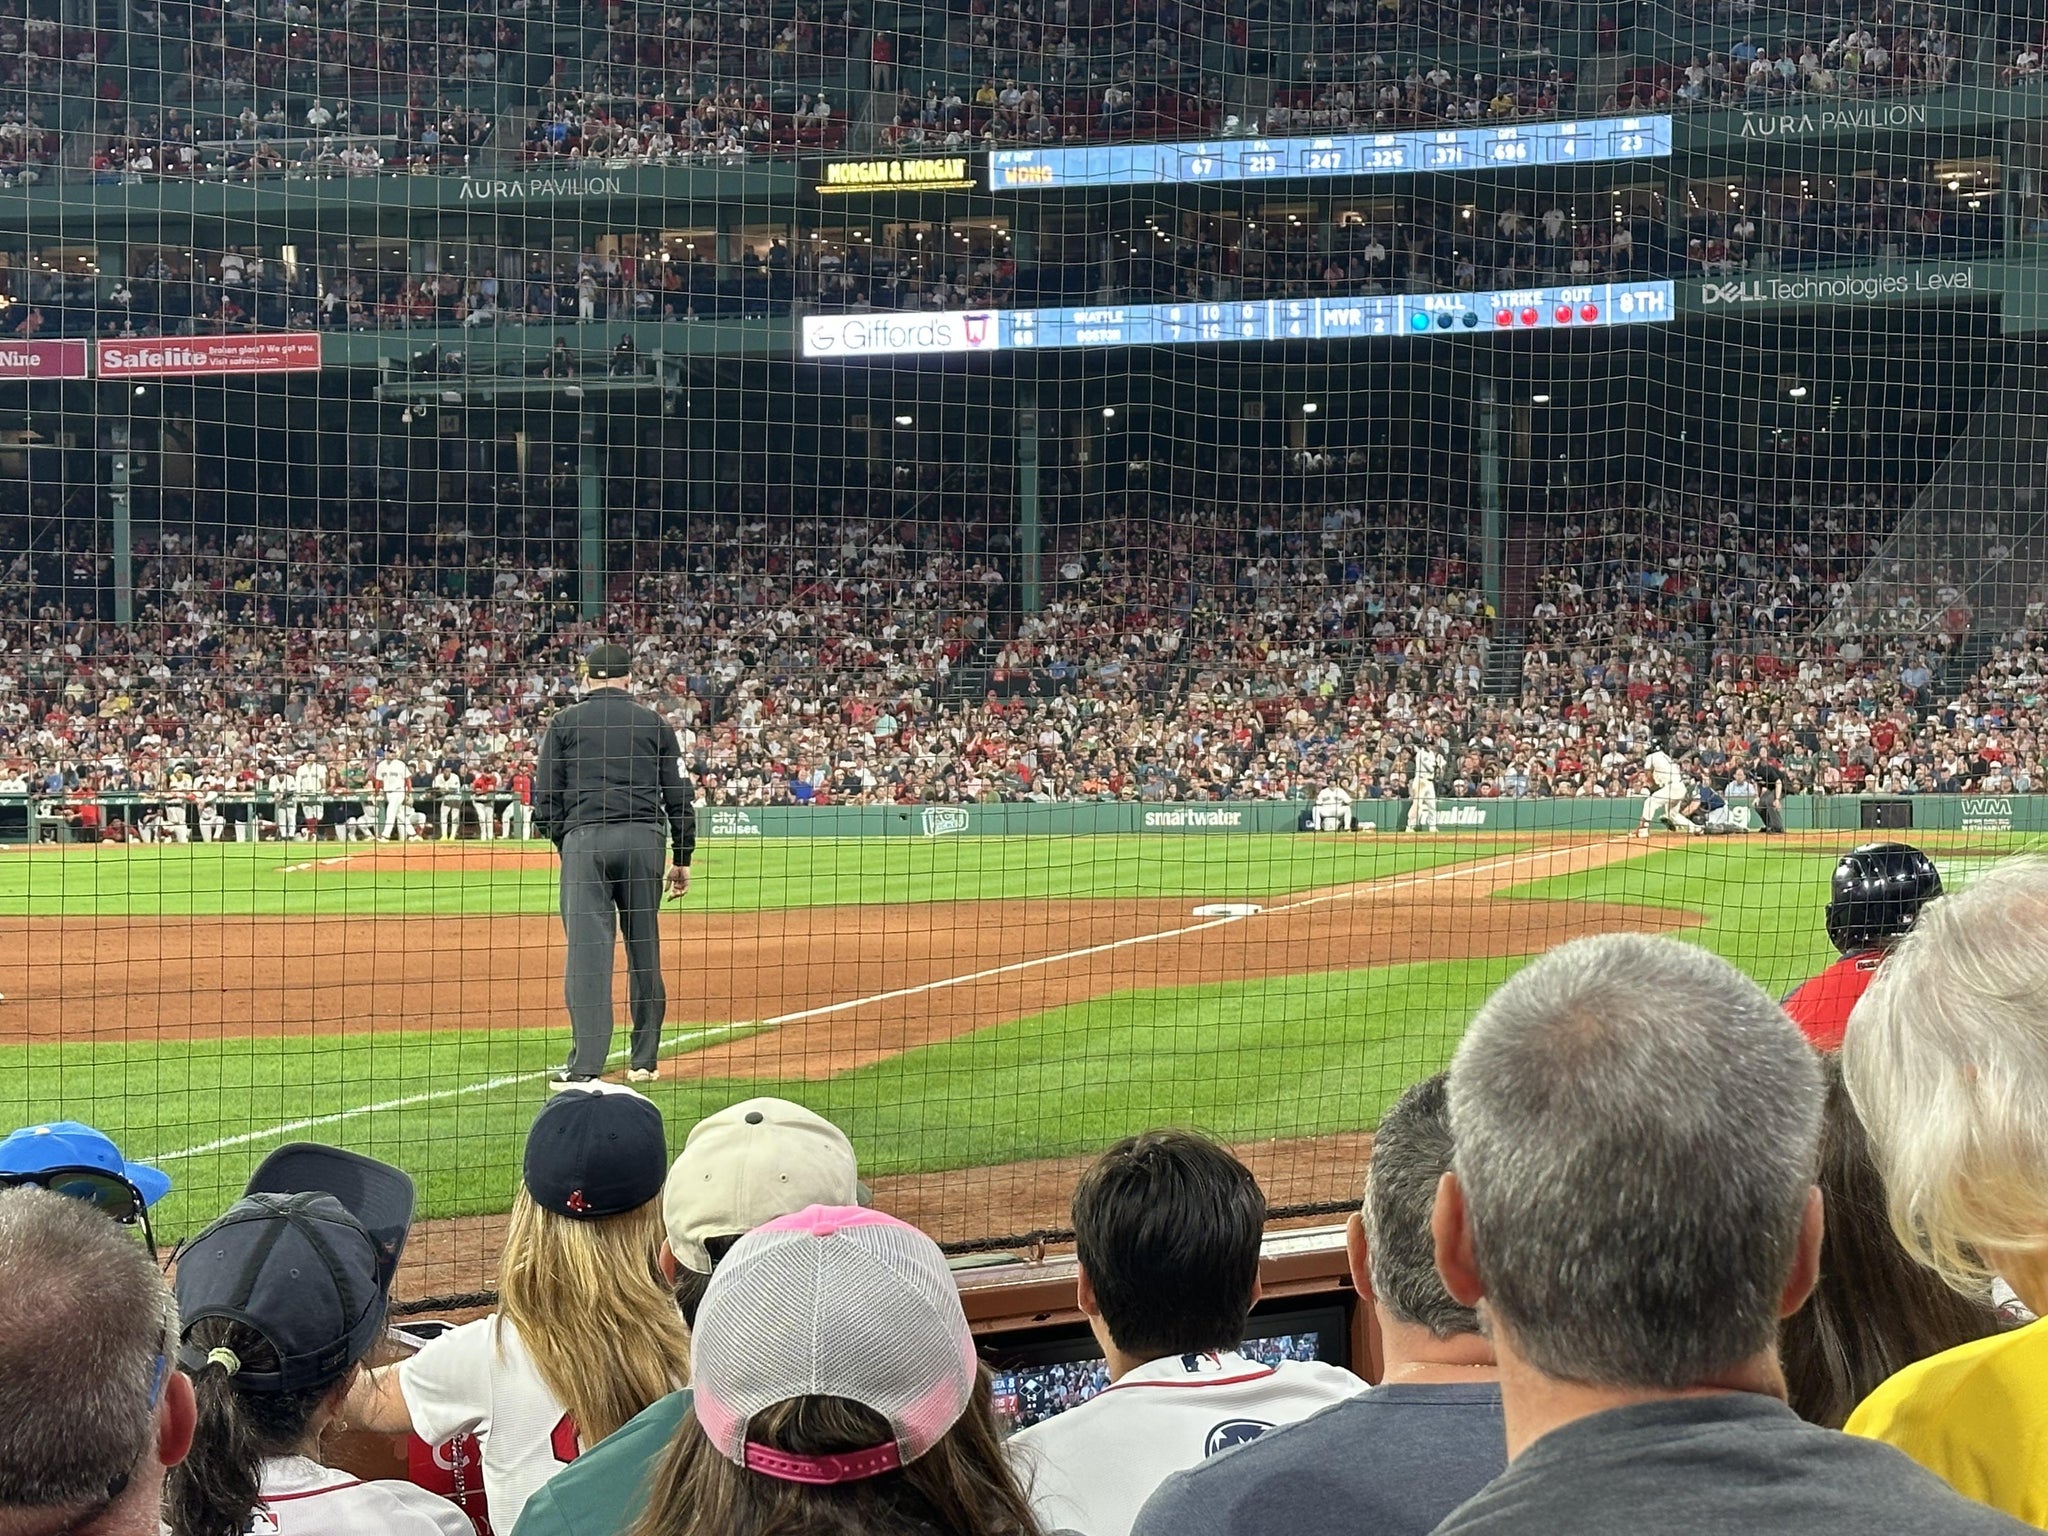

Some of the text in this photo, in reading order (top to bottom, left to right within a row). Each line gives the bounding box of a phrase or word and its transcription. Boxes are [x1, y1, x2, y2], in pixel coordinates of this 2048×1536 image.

[1822, 104, 1925, 131] PAVILION
[1563, 139, 1575, 156] 4
[1620, 135, 1643, 151] 23
[1366, 150, 1404, 167] .325
[1431, 148, 1462, 164] .371
[1489, 144, 1527, 161] .696
[1192, 159, 1212, 175] 67
[1249, 156, 1275, 172] 213
[1306, 153, 1341, 169] .247
[828, 159, 962, 184] MORGAN & MORGAN
[1005, 166, 1053, 184] WONG
[530, 177, 620, 197] PAVILION
[1702, 267, 1972, 304] DELL Technologies Level
[1424, 295, 1466, 310] BALL
[1491, 291, 1544, 307] STRIKE
[1561, 288, 1593, 302] OUT
[1620, 291, 1665, 313] 8TH
[1202, 305, 1220, 320] 10
[1243, 304, 1253, 319] 0
[1376, 299, 1382, 314] 1
[1014, 312, 1033, 328] 75
[1324, 308, 1361, 326] MVR
[1171, 325, 1181, 339] 7
[1202, 324, 1220, 339] 10
[1243, 323, 1253, 337] 0
[1290, 320, 1300, 336] 4
[1374, 318, 1384, 333] 2
[842, 319, 952, 349] Gifford's
[104, 347, 207, 368] Safelite
[282, 345, 296, 354] got
[297, 345, 315, 354] you.
[0, 351, 40, 367] Nine
[1961, 799, 2013, 815] WM
[712, 811, 736, 825] city
[1145, 808, 1241, 826] smartwater
[1008, 1378, 1015, 1388] 8
[1008, 1396, 1015, 1406] 7
